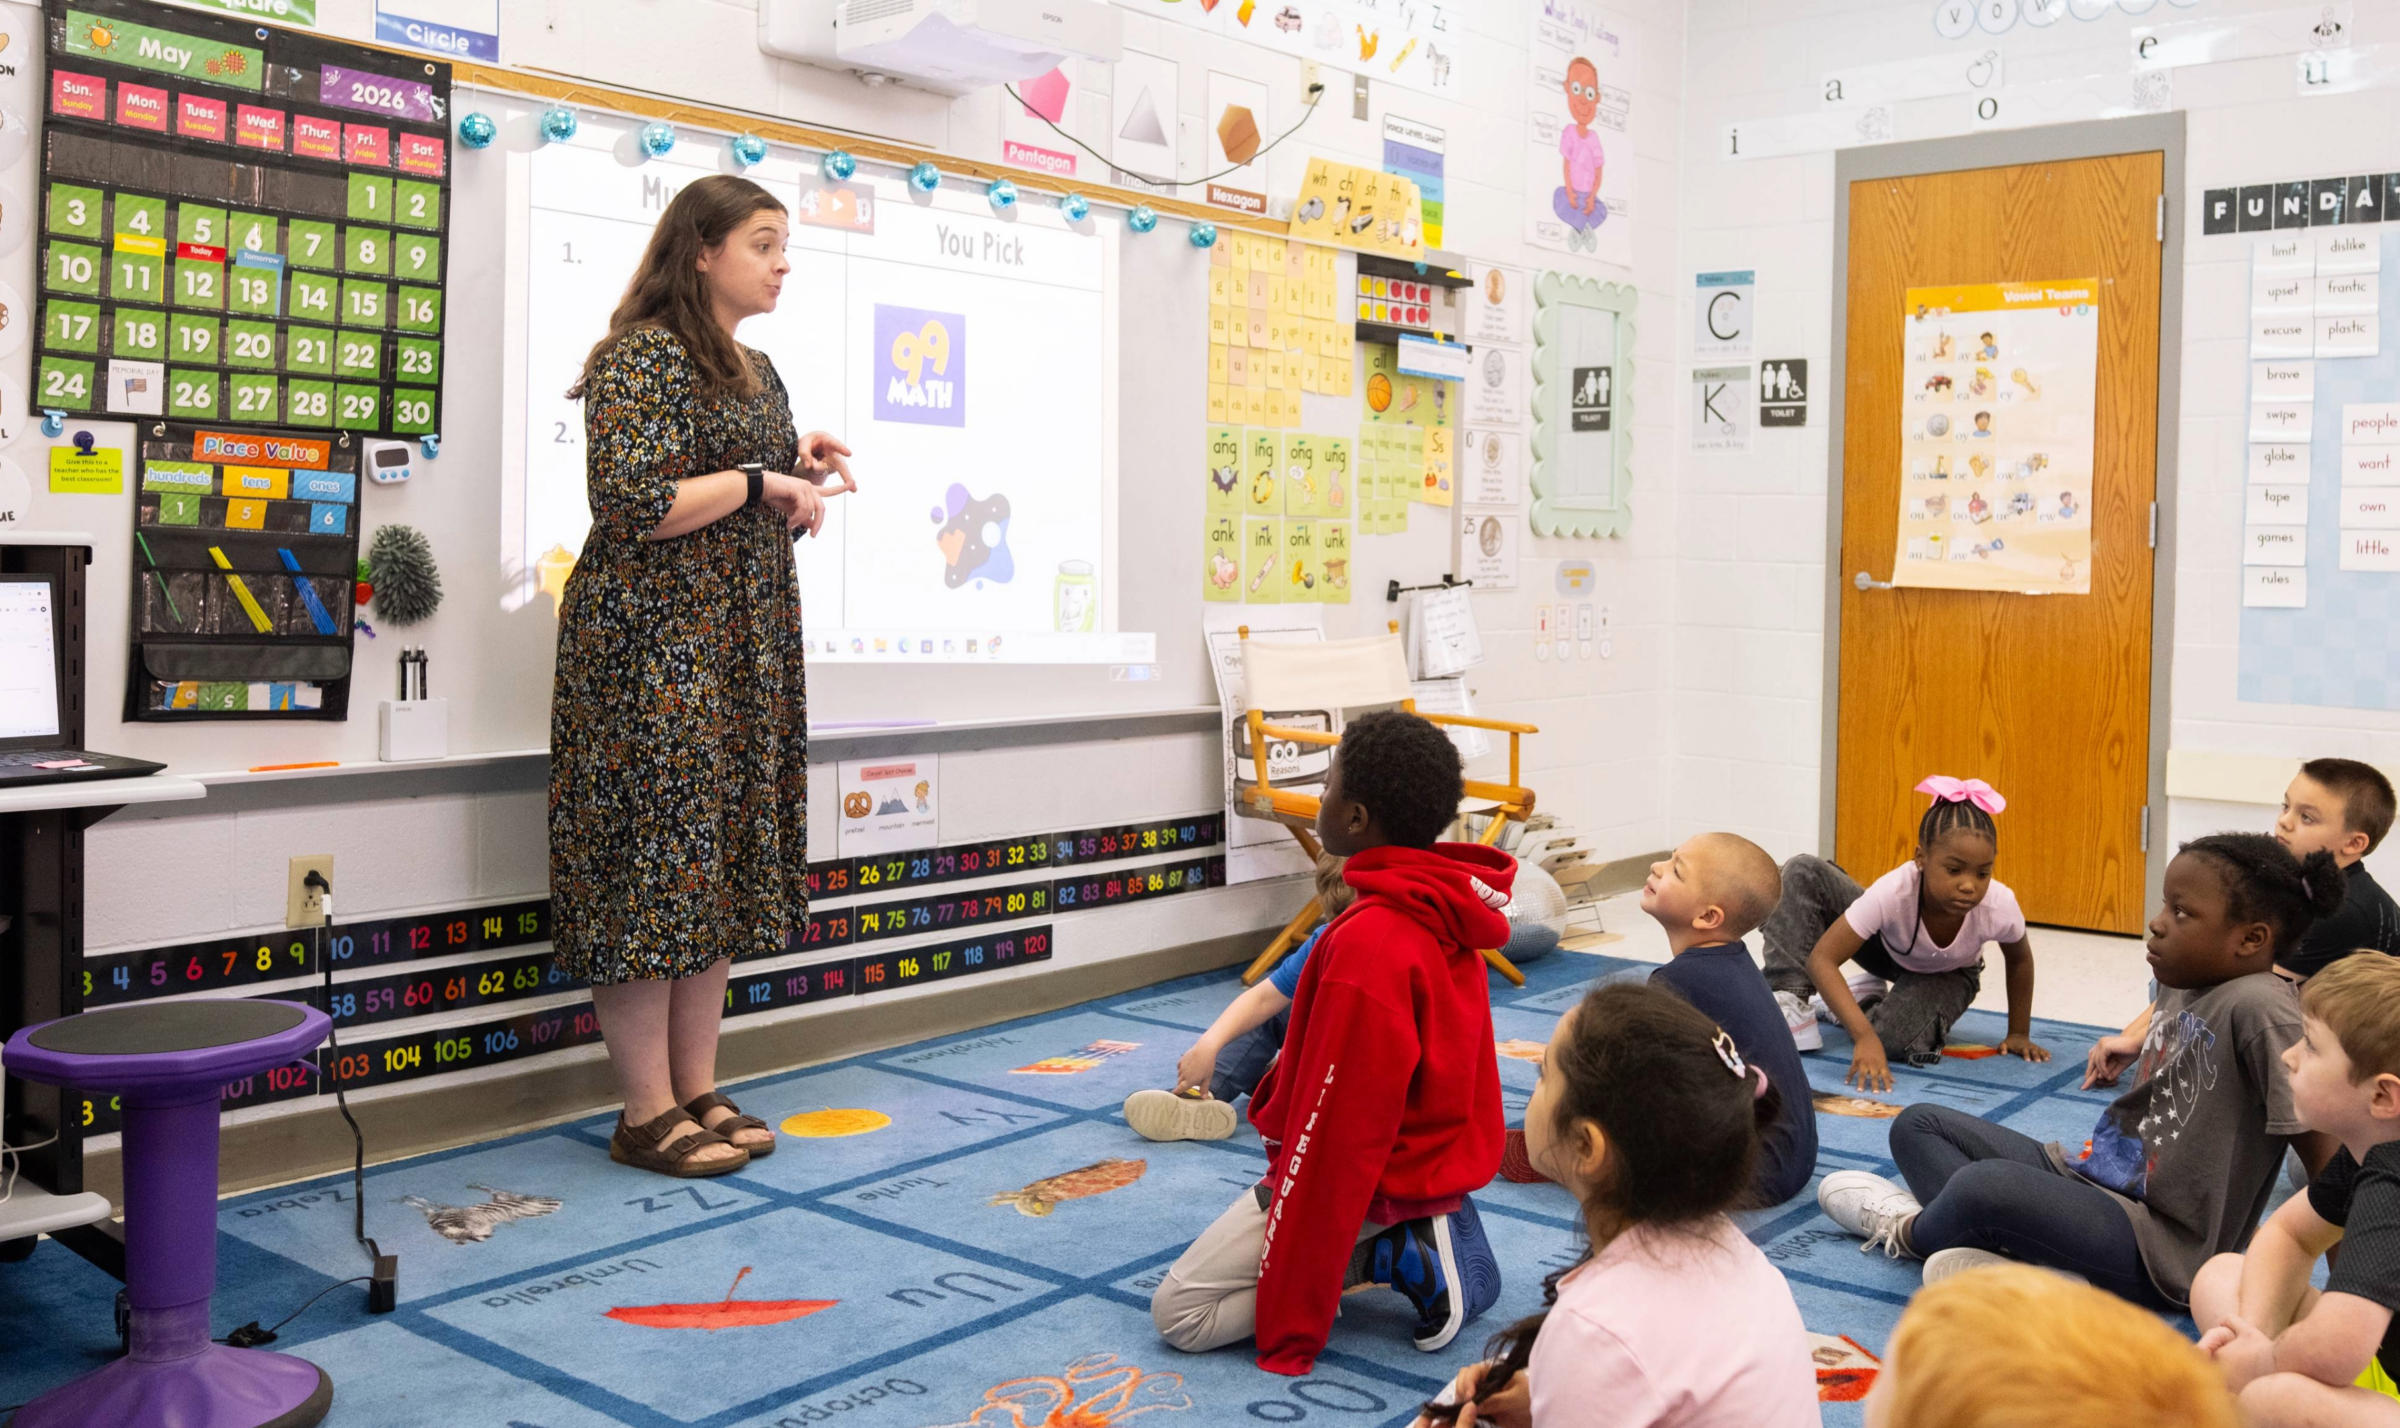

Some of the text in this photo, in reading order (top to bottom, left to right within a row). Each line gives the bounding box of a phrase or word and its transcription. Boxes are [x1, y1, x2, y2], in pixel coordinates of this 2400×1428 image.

[1042, 12, 1063, 24] EPSON
[406, 23, 470, 51] Circle
[2139, 34, 2158, 60] e
[139, 37, 192, 70] May
[2305, 60, 2331, 85] u
[62, 80, 93, 98] Sun.
[352, 83, 405, 110] 2026
[1825, 77, 1844, 101] a
[62, 97, 93, 112] Sunday
[127, 94, 161, 110] Mon.
[186, 103, 217, 120] Tues.
[1977, 96, 1999, 120] o
[124, 108, 158, 123] Monday
[184, 119, 216, 134] Tuesday
[246, 114, 278, 131] Wed.
[302, 124, 331, 140] Thur.
[357, 133, 376, 147] Fri.
[1730, 128, 1739, 154] i
[301, 139, 334, 154] Thursday
[355, 148, 377, 160] Friday
[412, 142, 434, 157] Sat.
[1008, 144, 1071, 171] Pentagon
[406, 157, 437, 171] Saturday
[1312, 164, 1328, 187] wh
[1120, 171, 1168, 194] Triangle
[1339, 169, 1354, 192] ch
[1365, 175, 1378, 197] sh
[1390, 180, 1401, 201] th
[366, 185, 376, 209] 1
[410, 194, 425, 217] 2
[1213, 188, 1261, 210] Hexagon
[67, 199, 86, 226] 3
[129, 209, 151, 235] 4
[193, 218, 211, 243] 5
[245, 223, 262, 252] 6
[190, 244, 212, 258] Today
[305, 233, 321, 257] 7
[359, 240, 376, 264] 8
[562, 242, 583, 266] 1.
[937, 223, 1024, 266] You Pick
[2272, 243, 2297, 257] limit
[2330, 238, 2366, 253] dislike
[59, 254, 92, 283] 10
[244, 251, 280, 264] Tomorrow
[410, 246, 426, 269] 9
[122, 263, 150, 291] 11
[184, 270, 213, 297] 12
[2328, 280, 2367, 294] frantic
[239, 278, 268, 308] 13
[299, 284, 328, 311] 14
[2003, 287, 2090, 303] Vowel Teams
[2268, 282, 2299, 301] upset
[351, 291, 377, 316] 15
[407, 298, 434, 323] 16
[59, 314, 91, 340] 17
[1708, 291, 1740, 340] C
[125, 321, 157, 348] 18
[180, 326, 210, 353] 19
[2263, 326, 2302, 336] excuse
[2328, 321, 2366, 340] plastic
[235, 332, 271, 358] 20
[296, 338, 326, 364] 21
[343, 343, 375, 368] 22
[891, 319, 950, 387] 99
[112, 365, 160, 376] MEMORIAL DAY
[403, 350, 433, 375] 23
[2267, 367, 2300, 380] brave
[45, 371, 87, 399] 24
[175, 382, 211, 408] 26
[888, 376, 953, 409] MATH
[238, 386, 272, 411] 27
[293, 391, 327, 417] 28
[343, 395, 375, 419] 29
[1704, 383, 1726, 423] K
[397, 400, 430, 424] 30
[1770, 409, 1796, 418] TOILET
[2266, 410, 2297, 425] swipe
[553, 421, 576, 444] 2.
[2352, 413, 2398, 435] people
[204, 437, 319, 462] Place Value
[1213, 442, 1237, 465] ang
[1254, 442, 1273, 467] ing
[1290, 447, 1313, 469] ong
[2264, 449, 2295, 467] globe
[1325, 450, 1346, 473] ung
[2358, 454, 2391, 470] want
[148, 468, 210, 485] hundreds
[242, 475, 270, 489] tens
[310, 479, 340, 493] ones
[177, 502, 183, 517] 1
[2264, 489, 2290, 507] tape
[2359, 502, 2386, 512] own
[241, 506, 251, 520] 5
[324, 512, 333, 525] 6
[1211, 521, 1235, 543] ank
[1255, 531, 1273, 547] ink
[1290, 529, 1311, 547] onk
[1325, 528, 1345, 549] unk
[2257, 533, 2294, 547] games
[2356, 540, 2390, 555] little
[2261, 571, 2290, 584] rules
[866, 770, 883, 778] Carpet
[1271, 766, 1300, 775] Reasons
[845, 826, 865, 836] pretzel
[879, 822, 905, 831] mountain
[911, 819, 935, 827] mermaid
[860, 861, 905, 885] 26 27
[113, 942, 304, 990] 4 5 6 7 8 9
[864, 934, 1047, 984] 115 116 117 118 119 120
[902, 1037, 1022, 1064] Xylophone
[938, 1107, 1040, 1126] Yy
[623, 1185, 740, 1214] Zz
[856, 1176, 950, 1202] Turtle
[237, 1189, 355, 1218] Zebra
[481, 1258, 663, 1309] Umbrella
[886, 1271, 1024, 1308] Uu
[762, 1378, 928, 1428] Octopu
[1246, 1378, 1388, 1423] Oo
